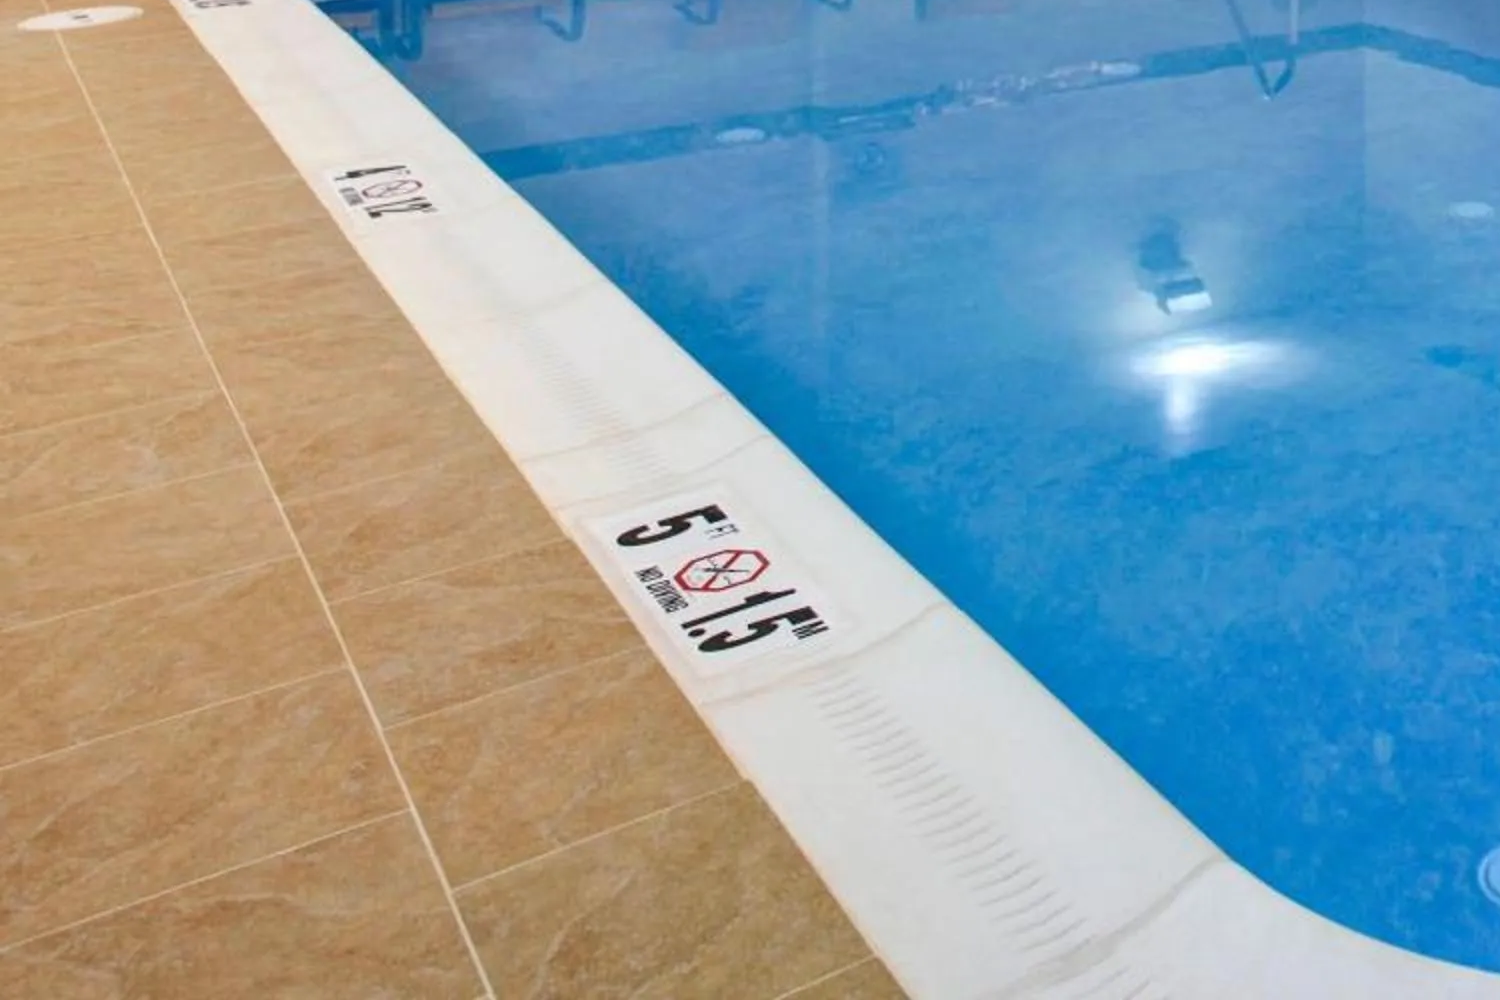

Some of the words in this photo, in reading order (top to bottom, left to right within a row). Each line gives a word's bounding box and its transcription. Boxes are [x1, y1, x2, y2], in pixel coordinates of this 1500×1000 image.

[616, 504, 728, 547] 5
[680, 588, 819, 653] 1.5
[634, 564, 665, 583] NO
[645, 579, 690, 614] DIVING
